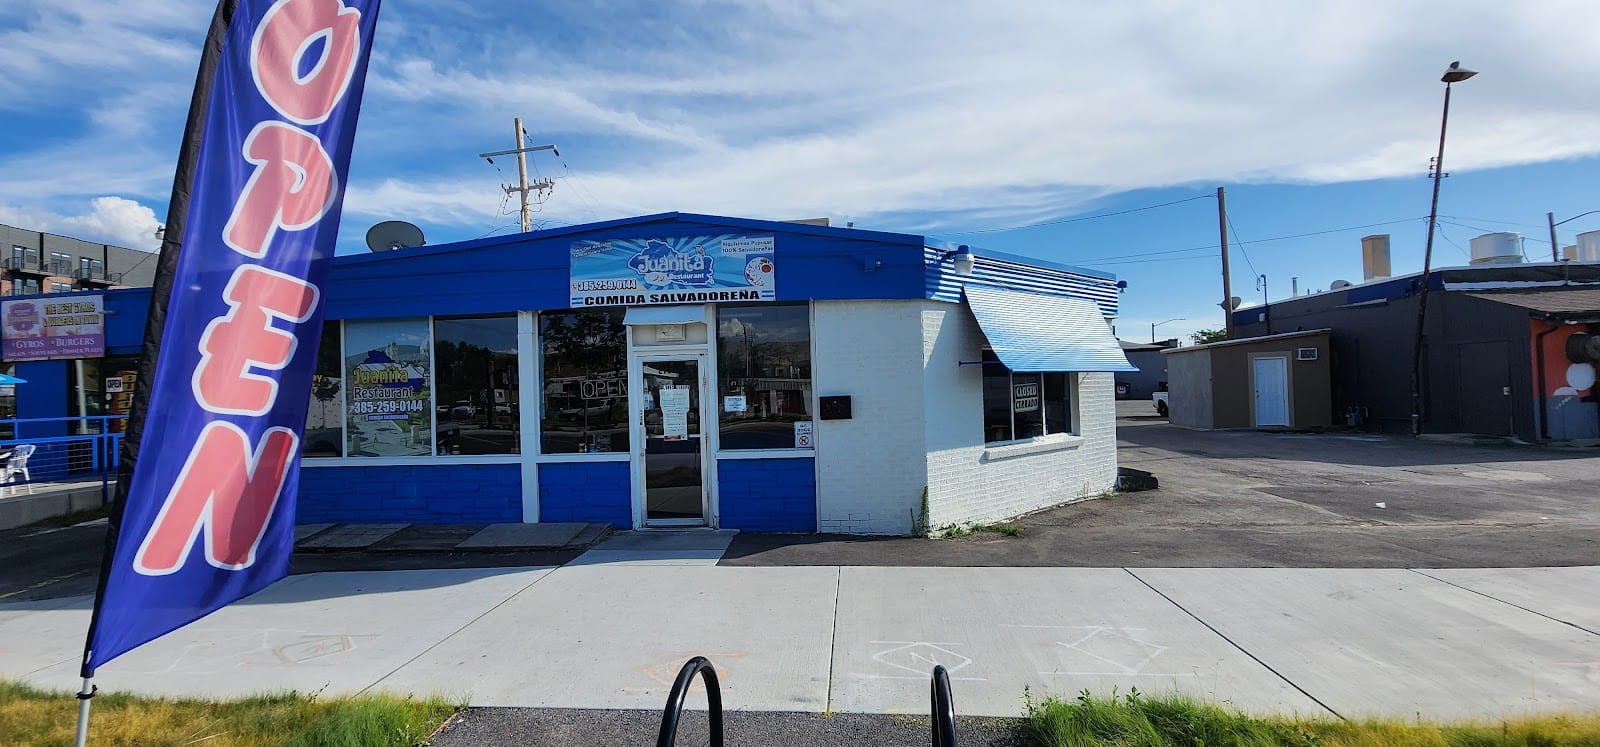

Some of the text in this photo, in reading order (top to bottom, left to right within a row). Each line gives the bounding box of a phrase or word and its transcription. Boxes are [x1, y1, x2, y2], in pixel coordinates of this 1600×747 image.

[637, 250, 705, 273] Juanita
[133, 0, 361, 576] OPEN
[584, 289, 760, 305] COMIDA SALVADOREÑA
[15, 337, 95, 349] GYROS BURGERS
[353, 368, 409, 384] Juanita
[107, 379, 122, 389] OPEN
[354, 386, 413, 399] Restaurant
[1016, 386, 1037, 397] CLOSED
[354, 401, 423, 413] 385-259-0144
[1016, 398, 1038, 409] CERRADO
